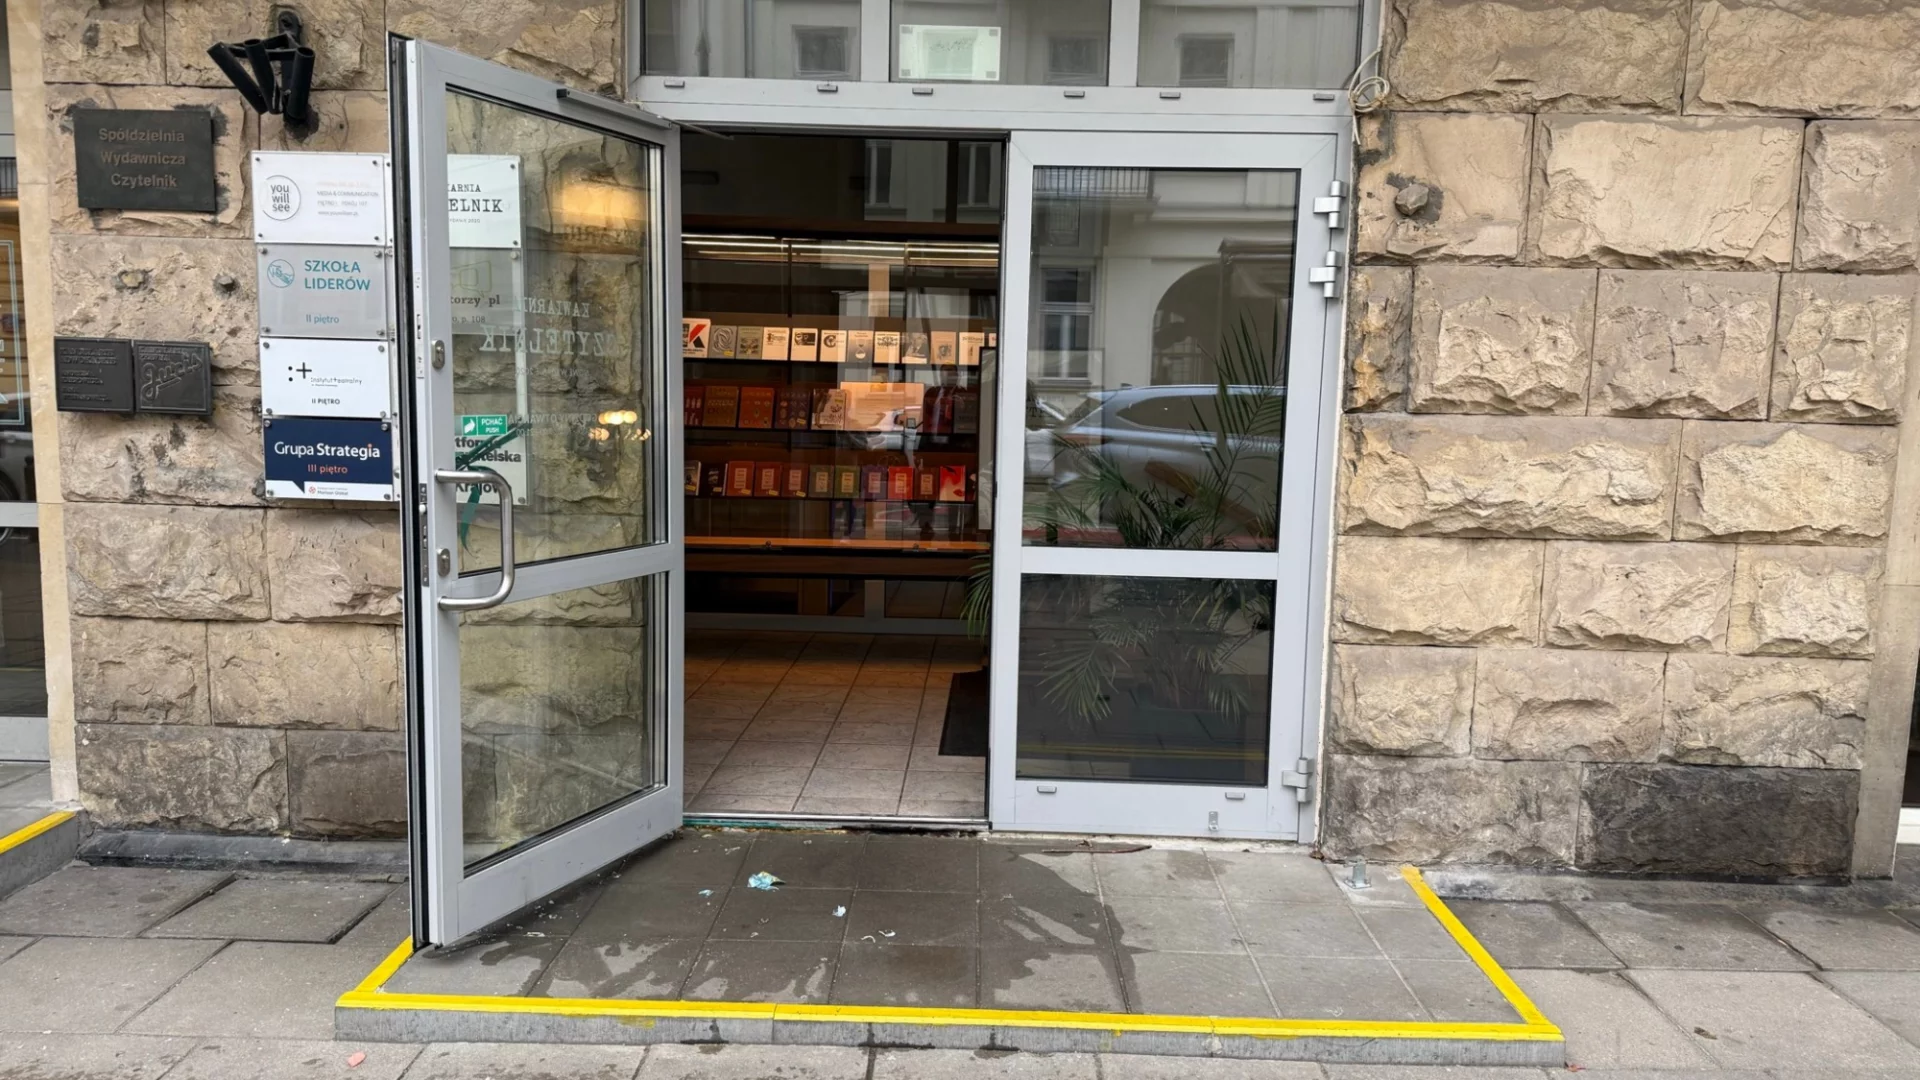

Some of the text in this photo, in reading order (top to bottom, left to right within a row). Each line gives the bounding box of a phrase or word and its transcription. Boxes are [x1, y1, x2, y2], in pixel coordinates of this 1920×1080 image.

[100, 151, 186, 166] Wydawnicza
[110, 173, 178, 189] Czytelnik
[270, 184, 290, 194] you
[271, 193, 290, 203] will
[272, 203, 291, 212] see
[304, 260, 361, 273] SZKOŁA
[304, 276, 371, 291] LIDERÓW
[314, 315, 340, 324] piętro
[317, 398, 341, 406] PIĘTRO
[481, 417, 503, 426] PCHAĆ
[274, 441, 380, 460] Grupa Strategia
[319, 464, 348, 475] piętro
